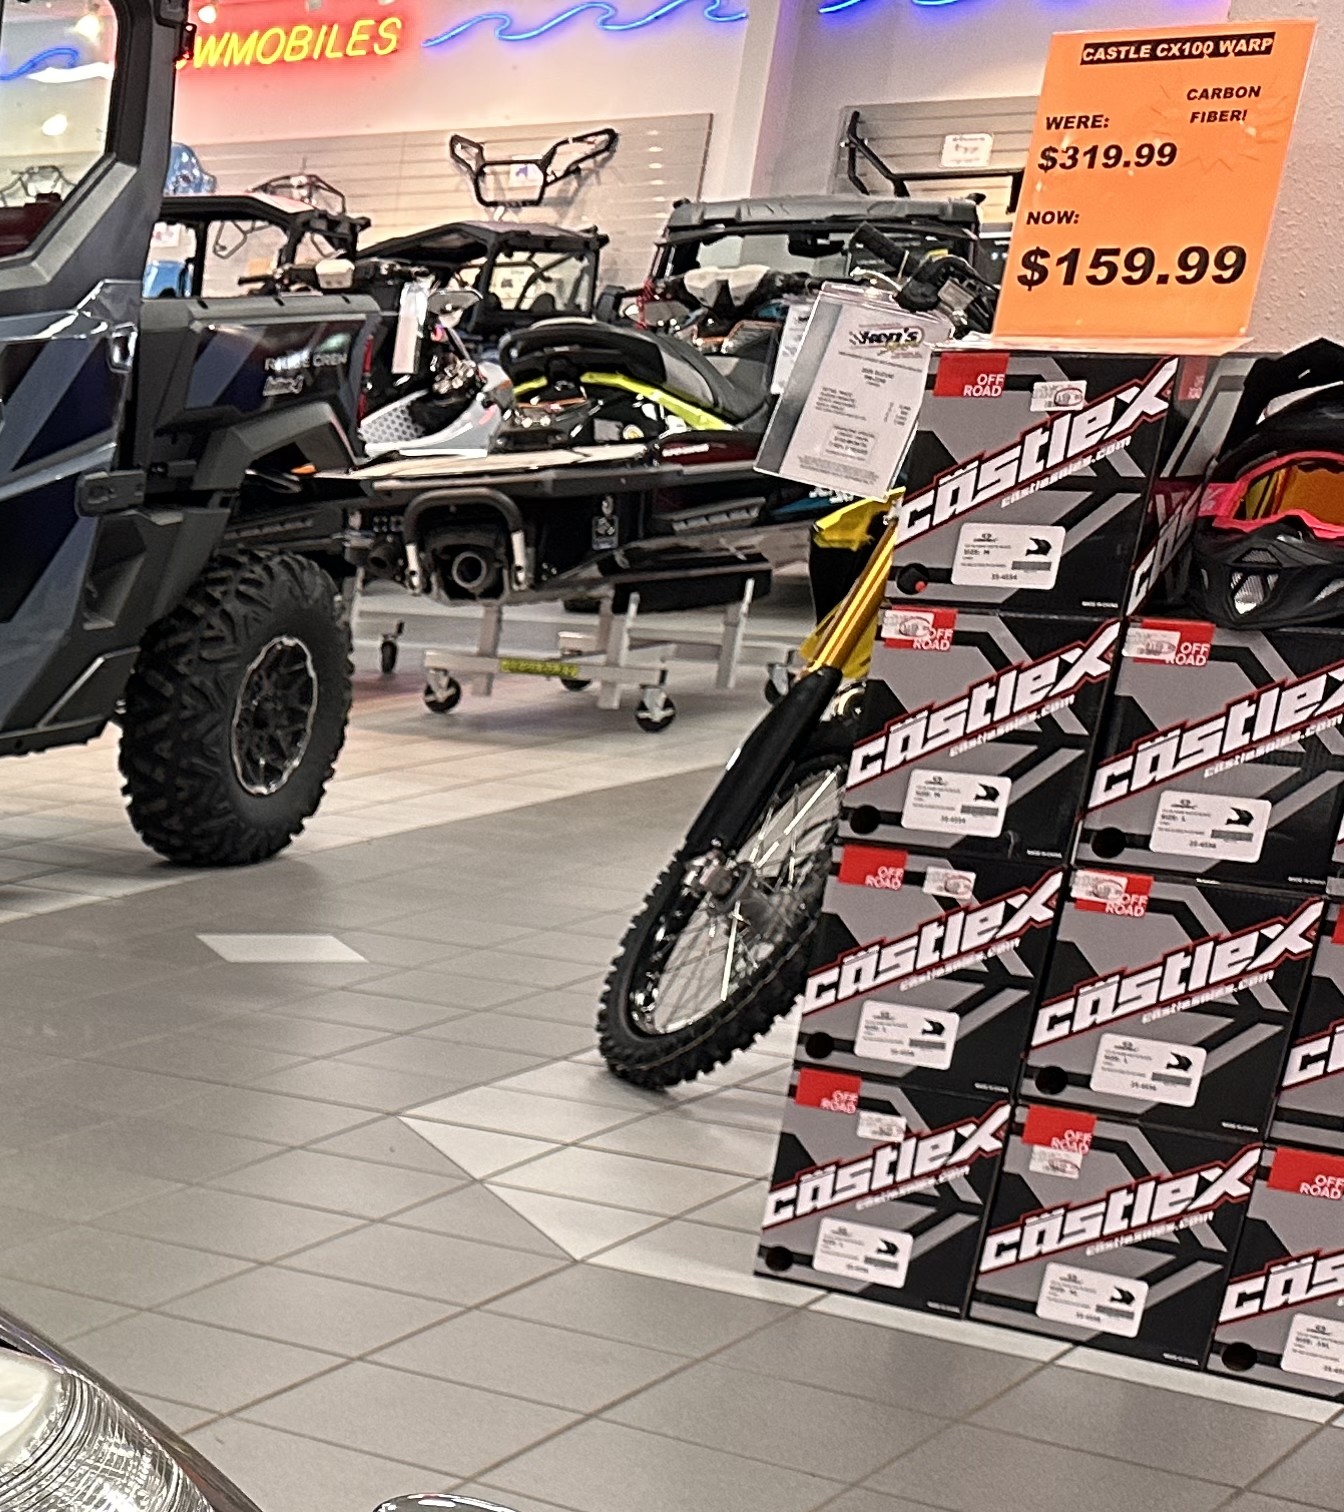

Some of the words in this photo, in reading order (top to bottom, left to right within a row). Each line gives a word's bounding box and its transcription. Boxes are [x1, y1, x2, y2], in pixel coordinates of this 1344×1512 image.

[176, 17, 402, 69] WMOBILES
[1082, 44, 1150, 62] CASTLE
[1156, 40, 1214, 58] CX100
[1219, 36, 1274, 54] WARP
[1186, 85, 1262, 101] CARBON
[1045, 115, 1110, 130] WERE:
[1190, 109, 1248, 124] FIBER!
[1037, 142, 1178, 173] $319.99
[1026, 210, 1080, 225] NOW:
[1017, 245, 1247, 292] $159.99
[976, 373, 1006, 386] OFF
[963, 384, 1002, 397] ROAD
[928, 628, 954, 640] OFF
[912, 638, 951, 650] ROAD
[1180, 642, 1211, 654] OFF
[877, 867, 904, 880] OFF
[865, 875, 902, 891] ROAD
[1121, 893, 1149, 906] OFF
[1105, 902, 1145, 917] ROAD
[1064, 1129, 1093, 1143] OFF
[1314, 1174, 1343, 1188] OFF
[1300, 1183, 1342, 1200] ROAD
